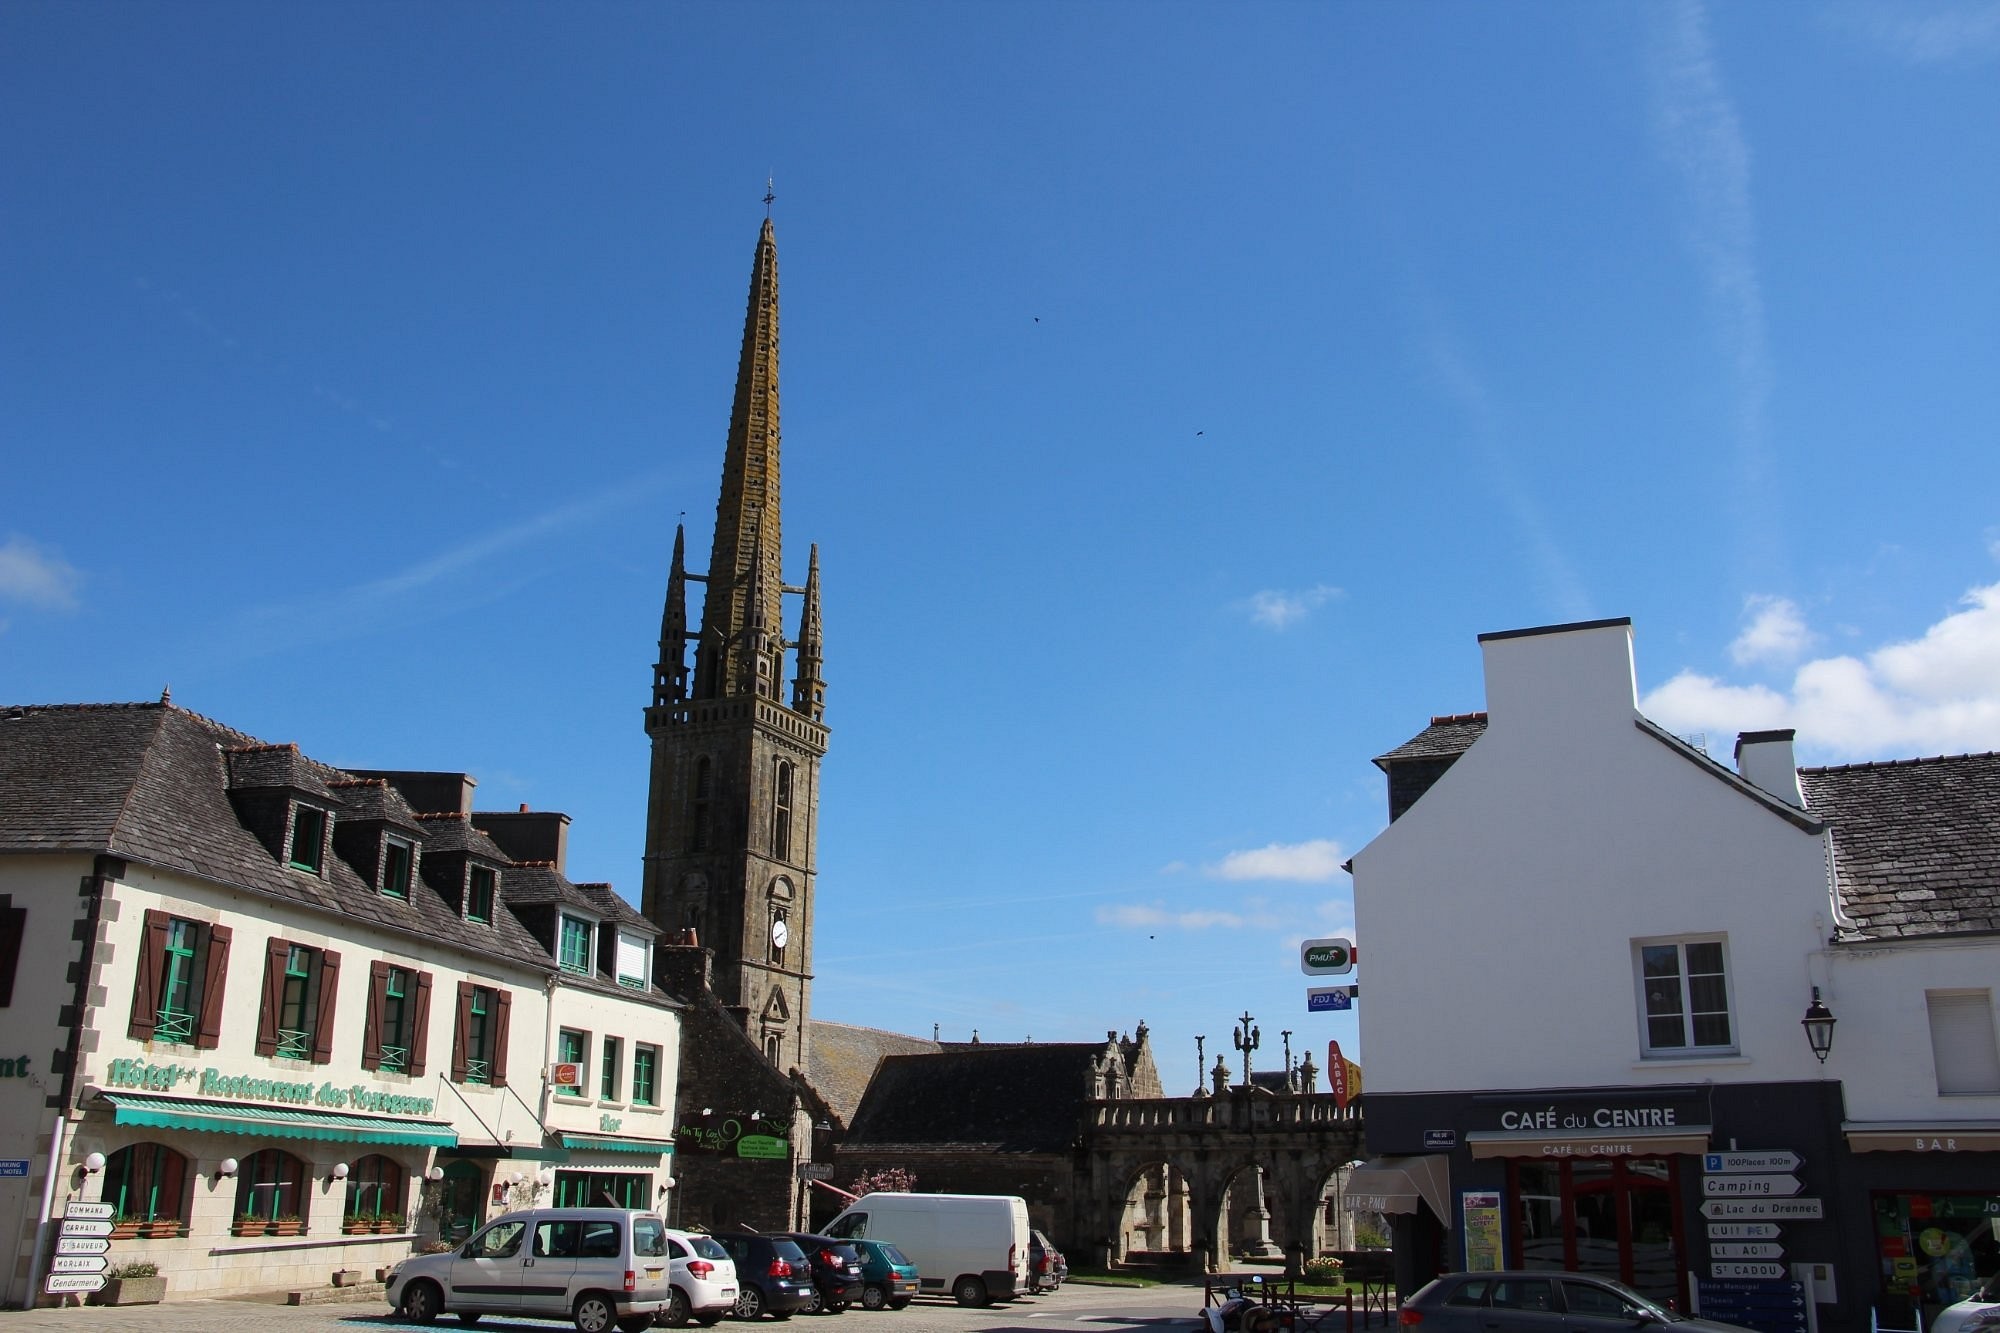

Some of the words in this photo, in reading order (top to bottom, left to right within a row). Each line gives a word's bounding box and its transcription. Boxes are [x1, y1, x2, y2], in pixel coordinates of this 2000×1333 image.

[1309, 953, 1329, 962] PMU
[1313, 995, 1330, 1004] FDJ
[1331, 1053, 1344, 1094] TABAC
[112, 1057, 178, 1087] Hôtel
[203, 1067, 315, 1102] Restaurant
[319, 1081, 349, 1106] des
[352, 1084, 435, 1115] Voyageurs
[1501, 1105, 1557, 1130] CAFÉ
[1563, 1113, 1587, 1128] du
[1593, 1108, 1676, 1128] CENTRE
[1542, 1143, 1573, 1155] CAFÉ
[1574, 1145, 1588, 1154] du
[1590, 1144, 1633, 1154] CENTRE
[1916, 1138, 1957, 1150] BAR
[1707, 1180, 1771, 1193] Camping
[1345, 1196, 1361, 1209] BAR
[1368, 1196, 1386, 1209] PMU
[69, 1206, 104, 1214] COMMANA
[1726, 1204, 1745, 1214] Lac
[1751, 1204, 1765, 1213] du
[1772, 1203, 1818, 1213] Drennec
[65, 1224, 97, 1232] CARHAIX
[57, 1260, 91, 1268] MORLAIX
[1734, 1265, 1777, 1275] CADOU
[52, 1279, 99, 1288] Gendarmerie
